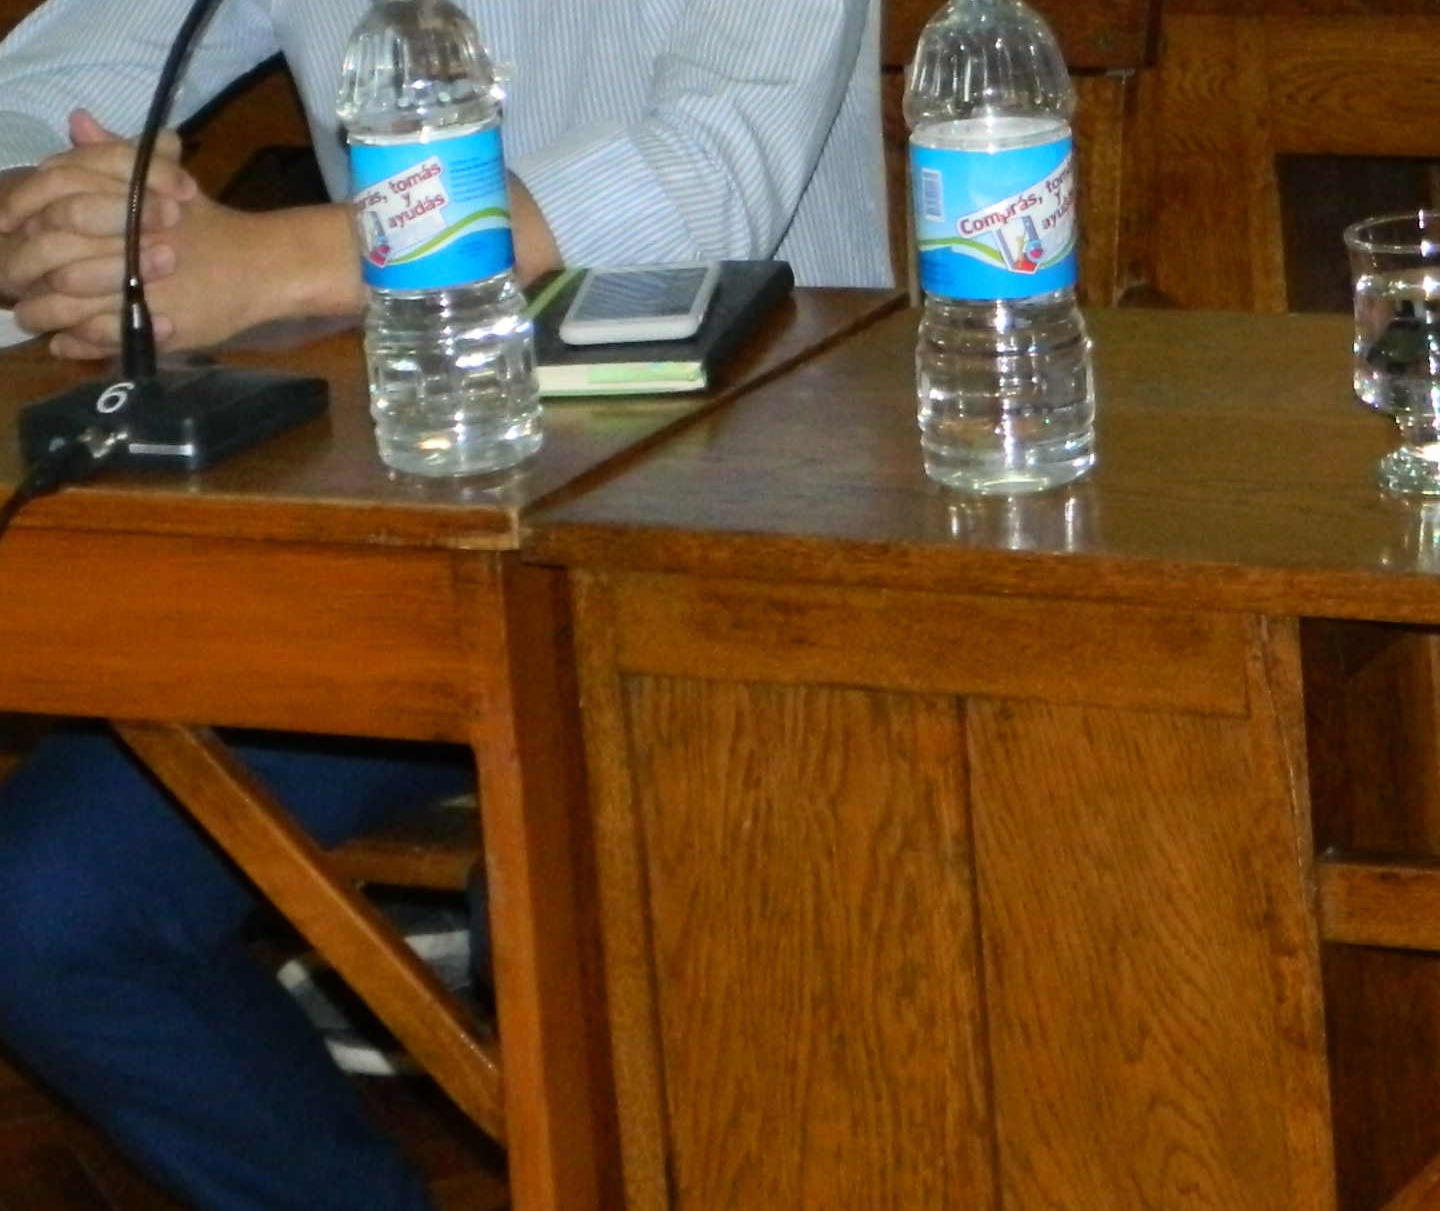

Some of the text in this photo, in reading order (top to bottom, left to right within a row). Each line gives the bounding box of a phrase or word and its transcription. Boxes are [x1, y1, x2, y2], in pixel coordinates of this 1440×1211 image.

[388, 163, 442, 194] tomás
[387, 193, 446, 228] ayudás
[401, 192, 411, 207] y
